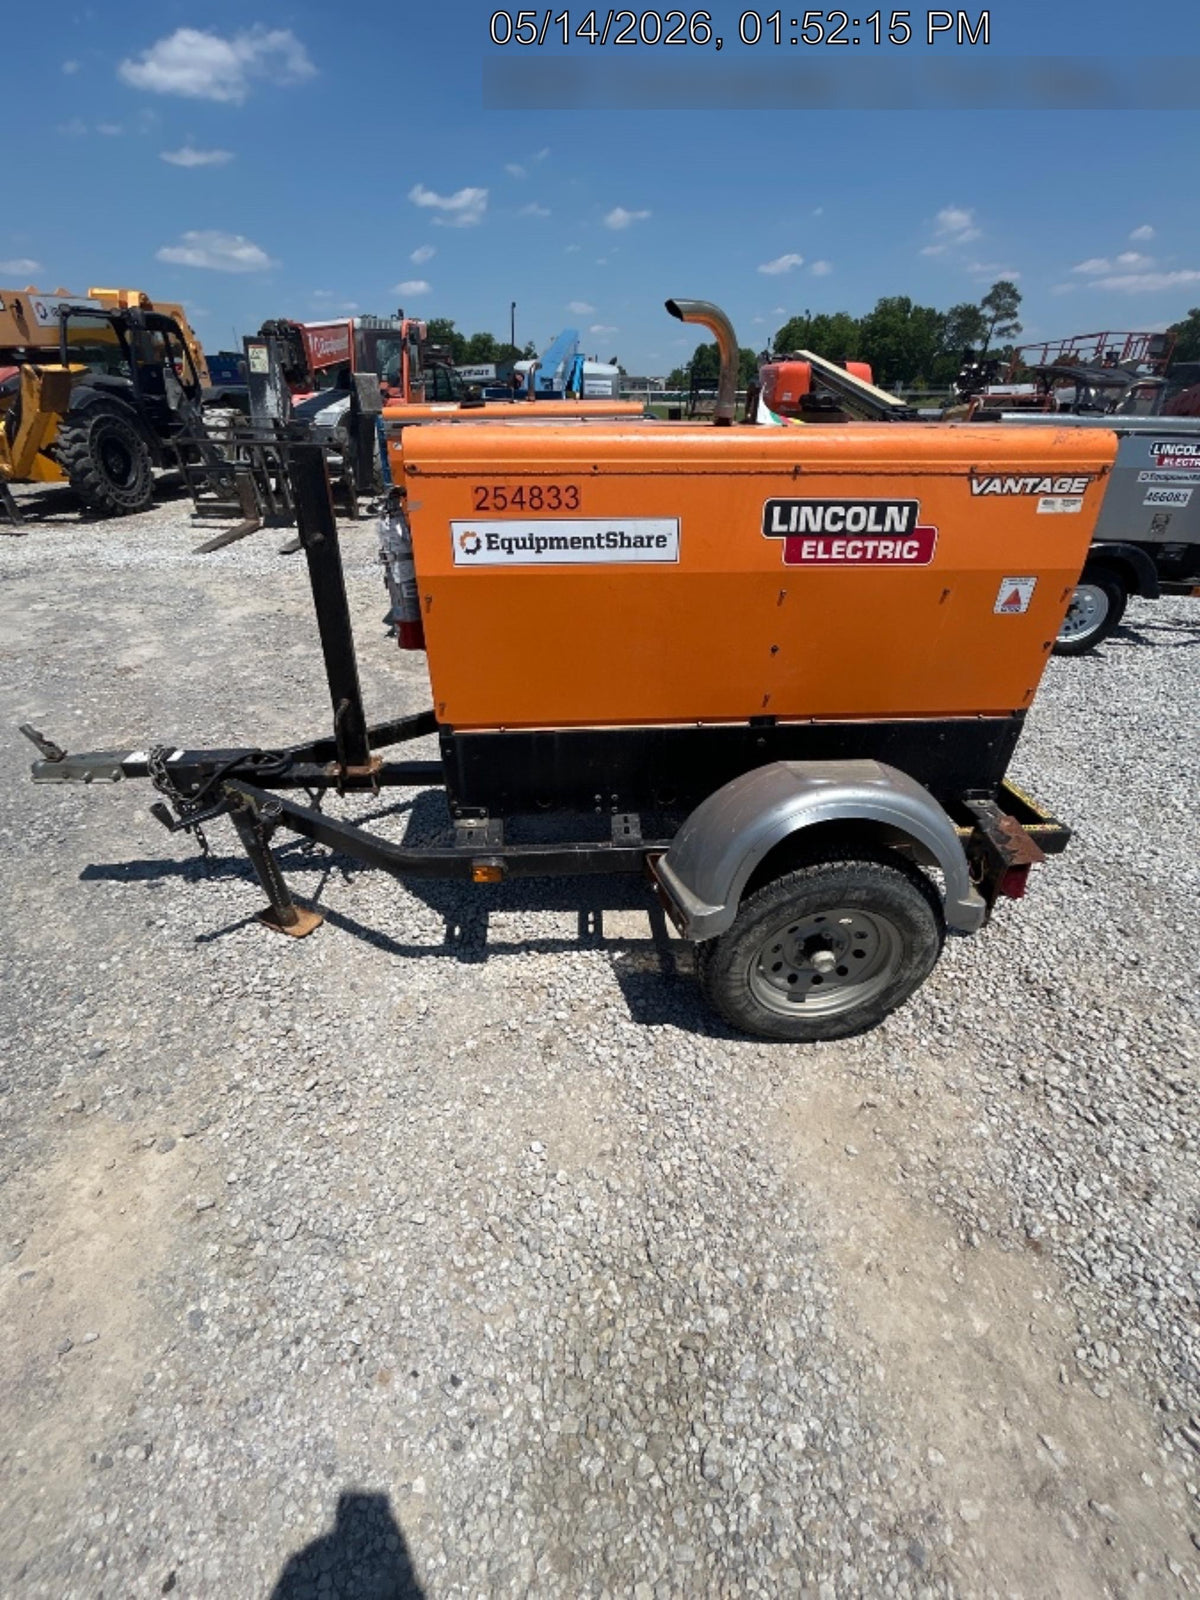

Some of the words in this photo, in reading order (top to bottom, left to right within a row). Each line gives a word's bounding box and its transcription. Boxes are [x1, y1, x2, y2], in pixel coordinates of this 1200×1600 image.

[970, 476, 1091, 495] VANTAGE
[474, 485, 580, 511] 254833
[771, 506, 909, 532] LINCOLN
[485, 531, 668, 554] EquipmentShare
[801, 540, 920, 559] ELECTRIC
